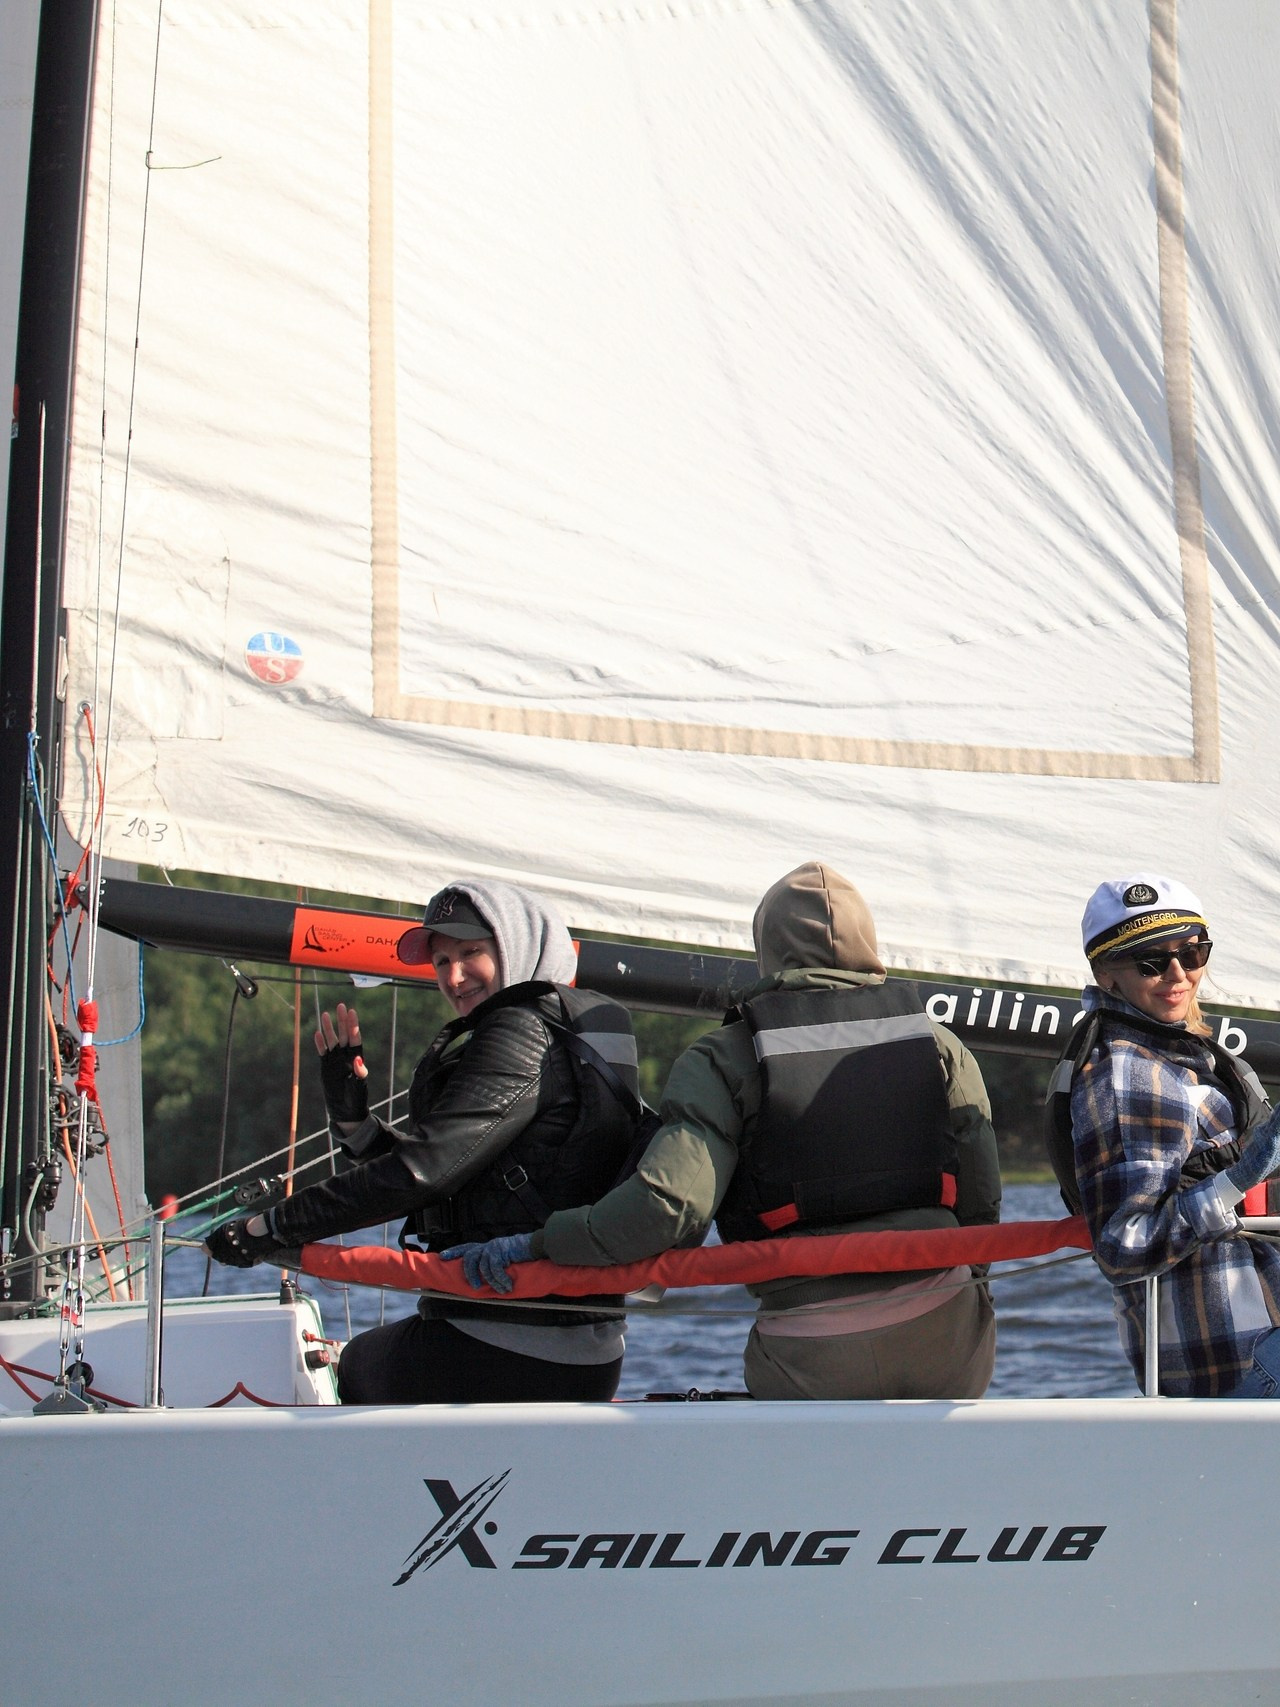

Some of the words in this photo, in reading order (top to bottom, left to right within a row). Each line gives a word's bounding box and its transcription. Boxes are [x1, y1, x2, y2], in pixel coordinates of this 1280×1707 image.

[122, 817, 168, 842] 103
[1117, 912, 1178, 936] MONTENEGRO
[512, 1529, 860, 1570] SAILING
[877, 1525, 1108, 1565] CLUB
